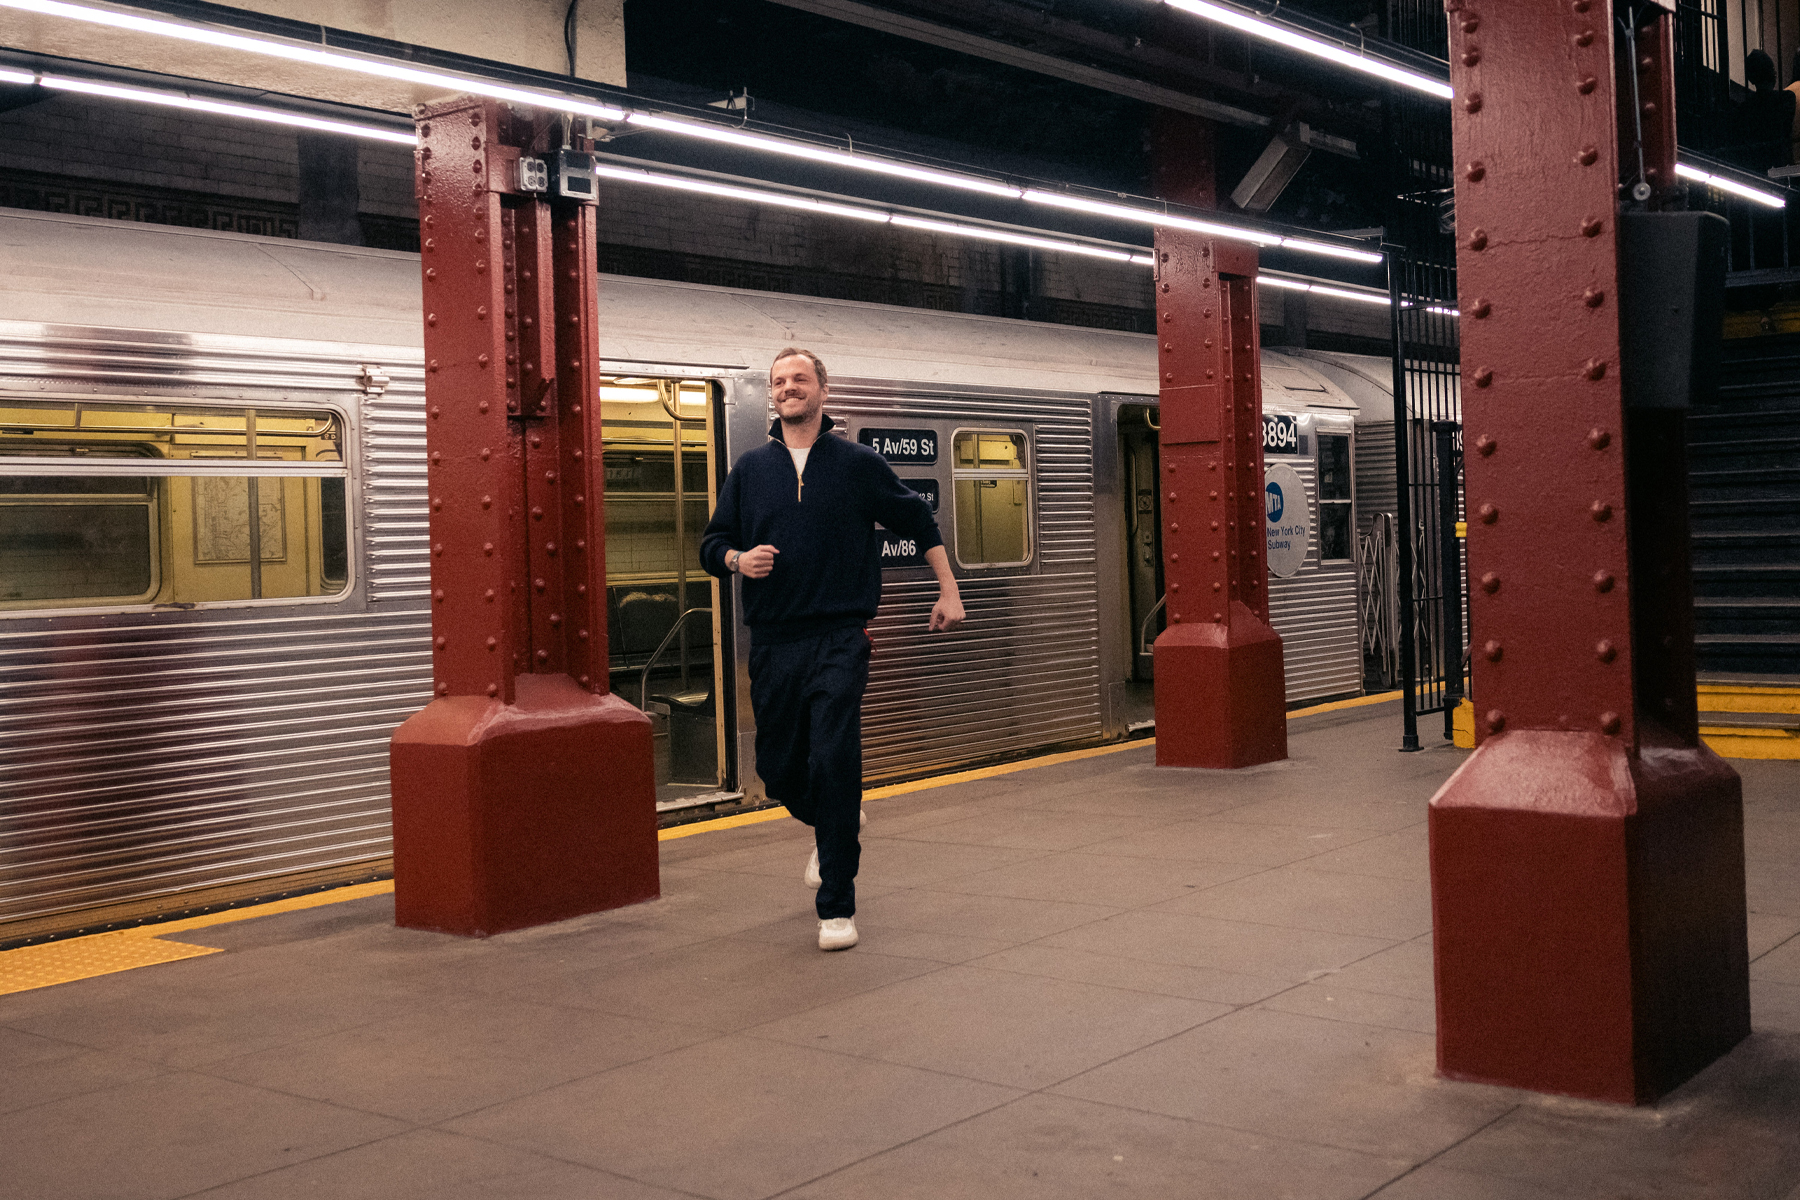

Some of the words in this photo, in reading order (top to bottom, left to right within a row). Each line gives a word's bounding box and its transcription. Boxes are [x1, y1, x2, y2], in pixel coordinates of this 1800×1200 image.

[872, 438, 880, 454] 5
[883, 438, 918, 455] Av/59
[921, 439, 935, 455] St
[926, 492, 934, 502] St
[1265, 491, 1281, 514] MTA
[1266, 527, 1279, 537] New
[1281, 526, 1293, 536] York
[1294, 525, 1306, 537] City
[881, 539, 916, 557] Av/86
[1267, 540, 1291, 550] Subway
